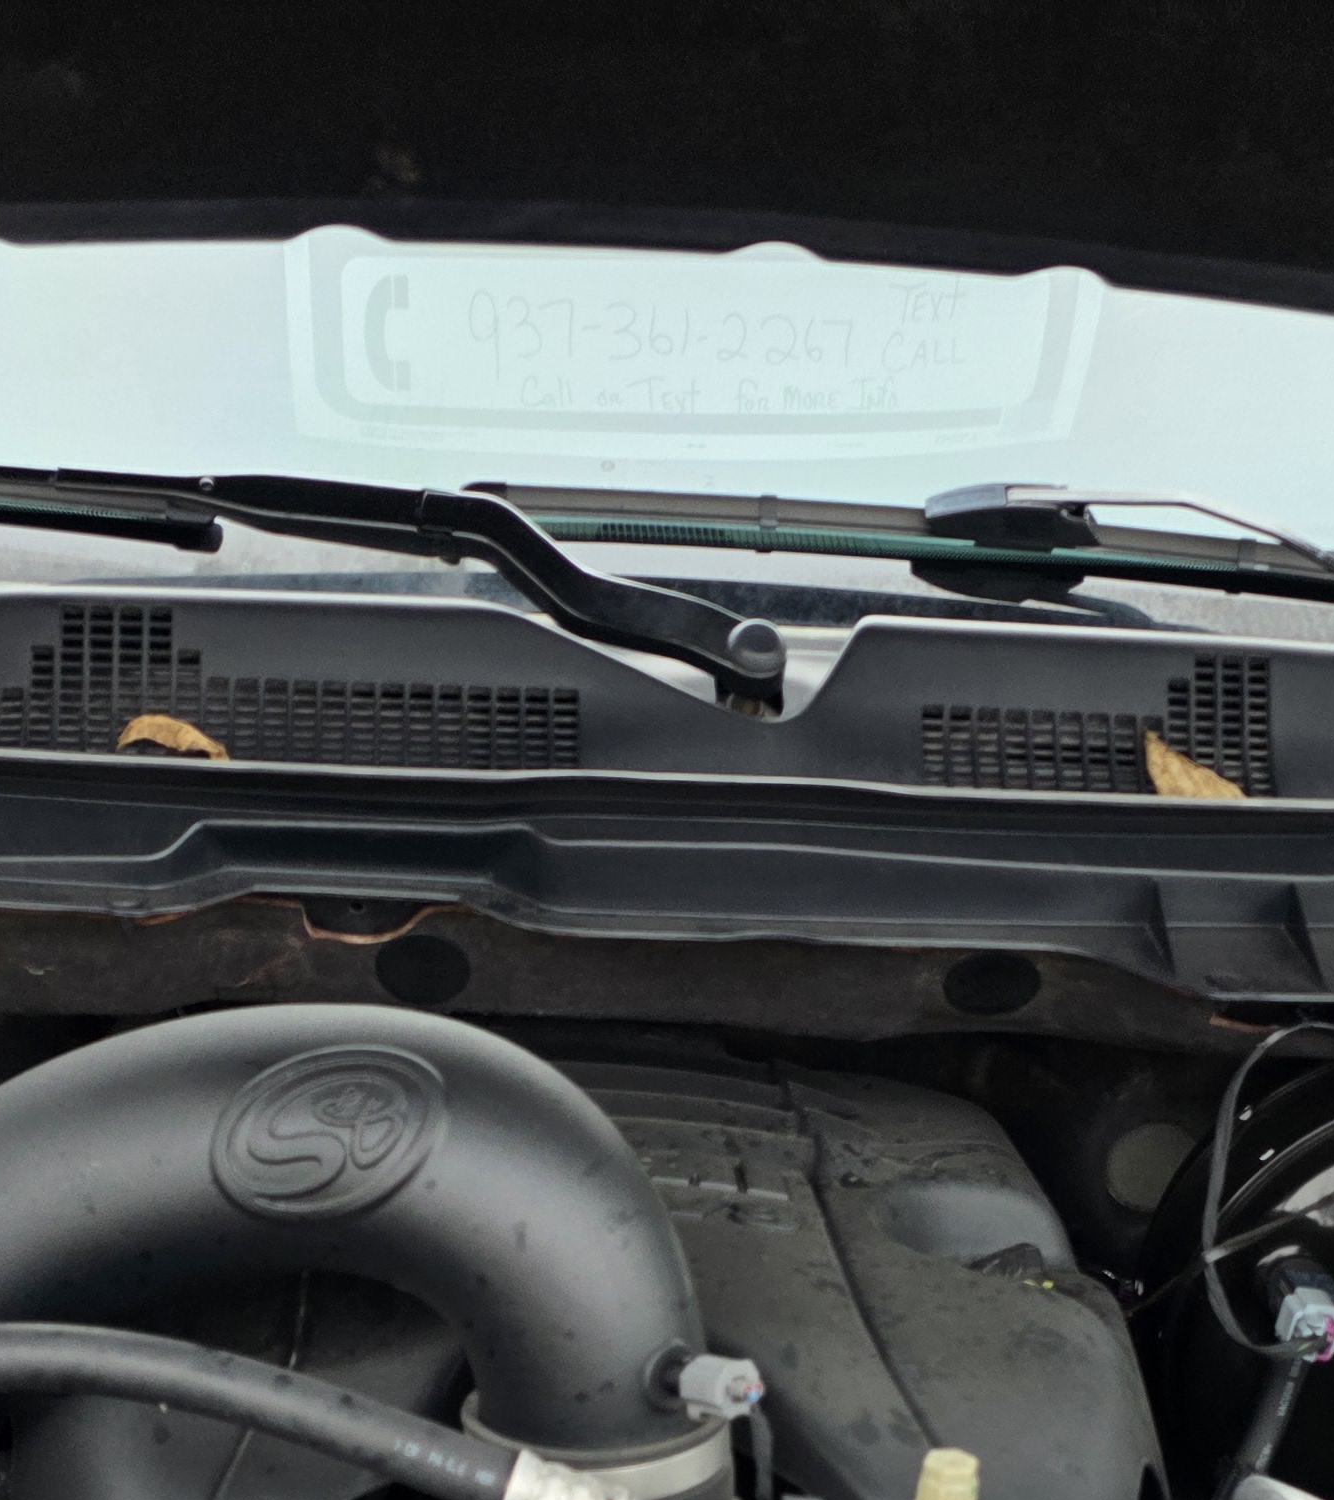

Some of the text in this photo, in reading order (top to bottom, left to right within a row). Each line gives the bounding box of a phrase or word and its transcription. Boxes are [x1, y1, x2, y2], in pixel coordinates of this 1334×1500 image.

[469, 288, 855, 381] 937-361-2267
[881, 331, 967, 374] CALL
[520, 374, 573, 407] Call
